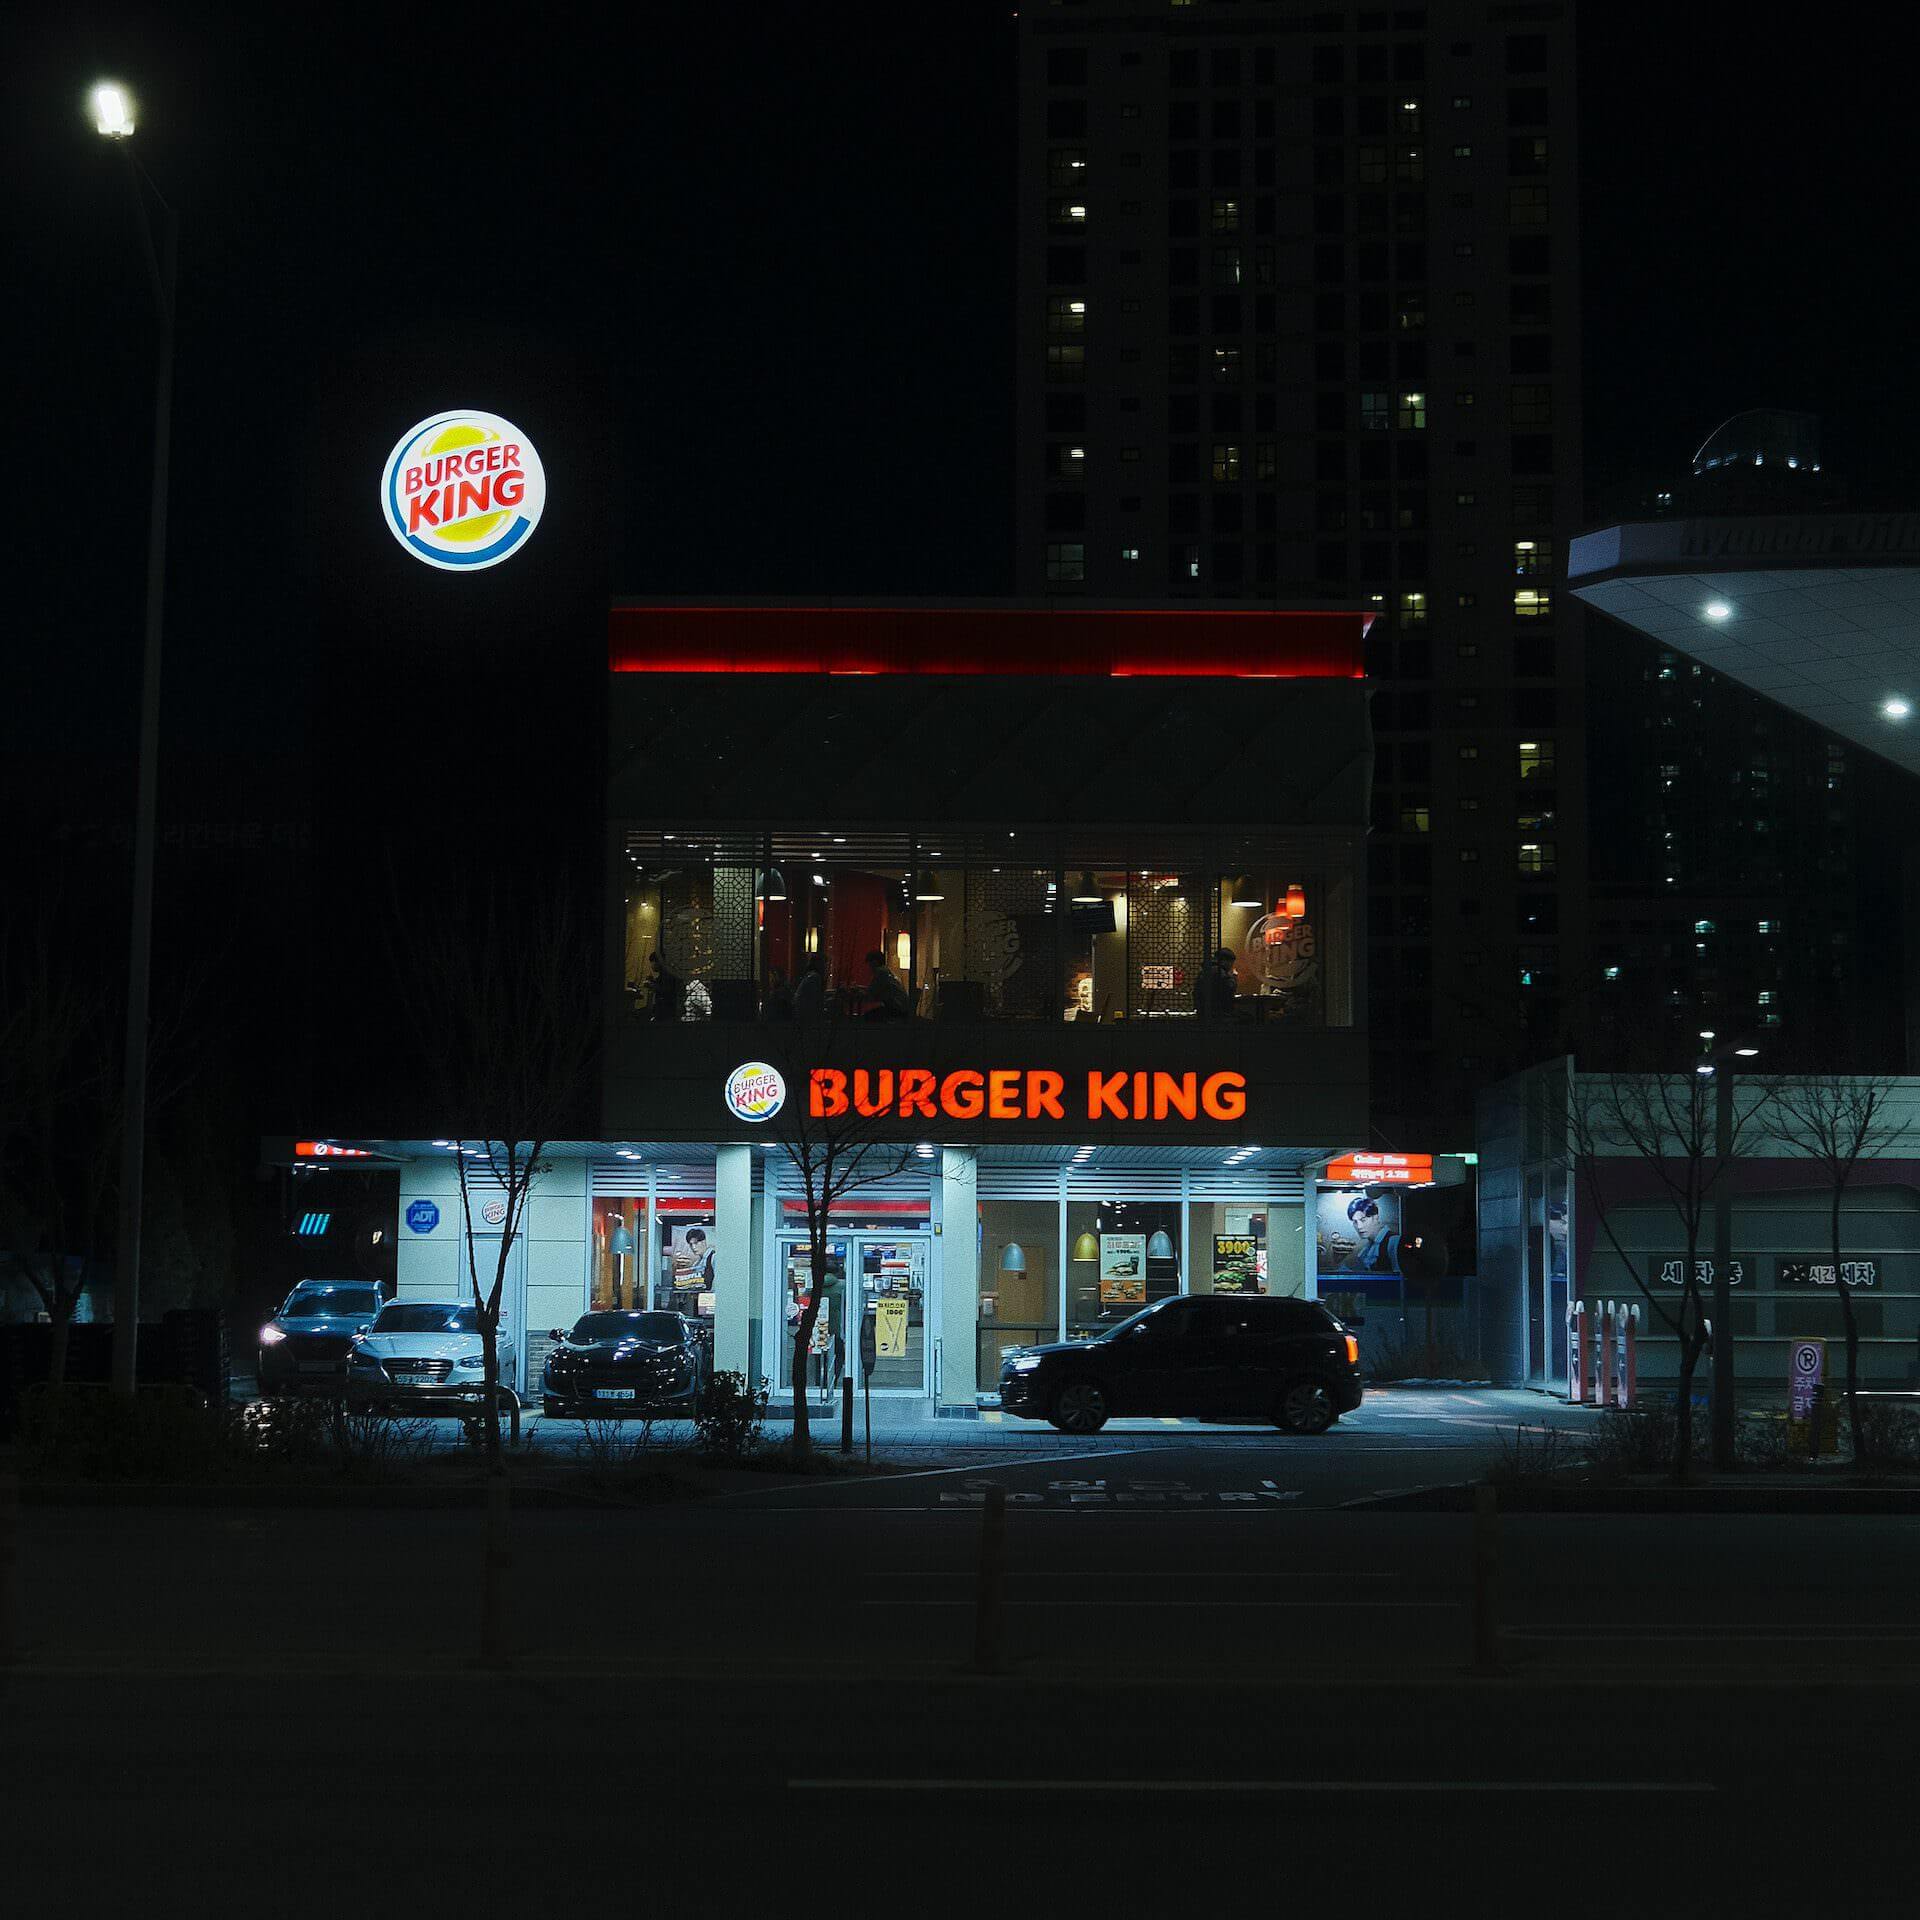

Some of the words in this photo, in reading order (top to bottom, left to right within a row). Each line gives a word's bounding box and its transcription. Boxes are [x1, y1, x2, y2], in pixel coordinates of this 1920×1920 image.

[405, 444, 520, 495] BURGER
[409, 470, 525, 533] KING
[734, 1074, 776, 1094] BURGER
[735, 1084, 778, 1108] KING
[809, 1069, 1064, 1120] BURGER
[1088, 1071, 1246, 1120] KING
[411, 1210, 435, 1223] ADT
